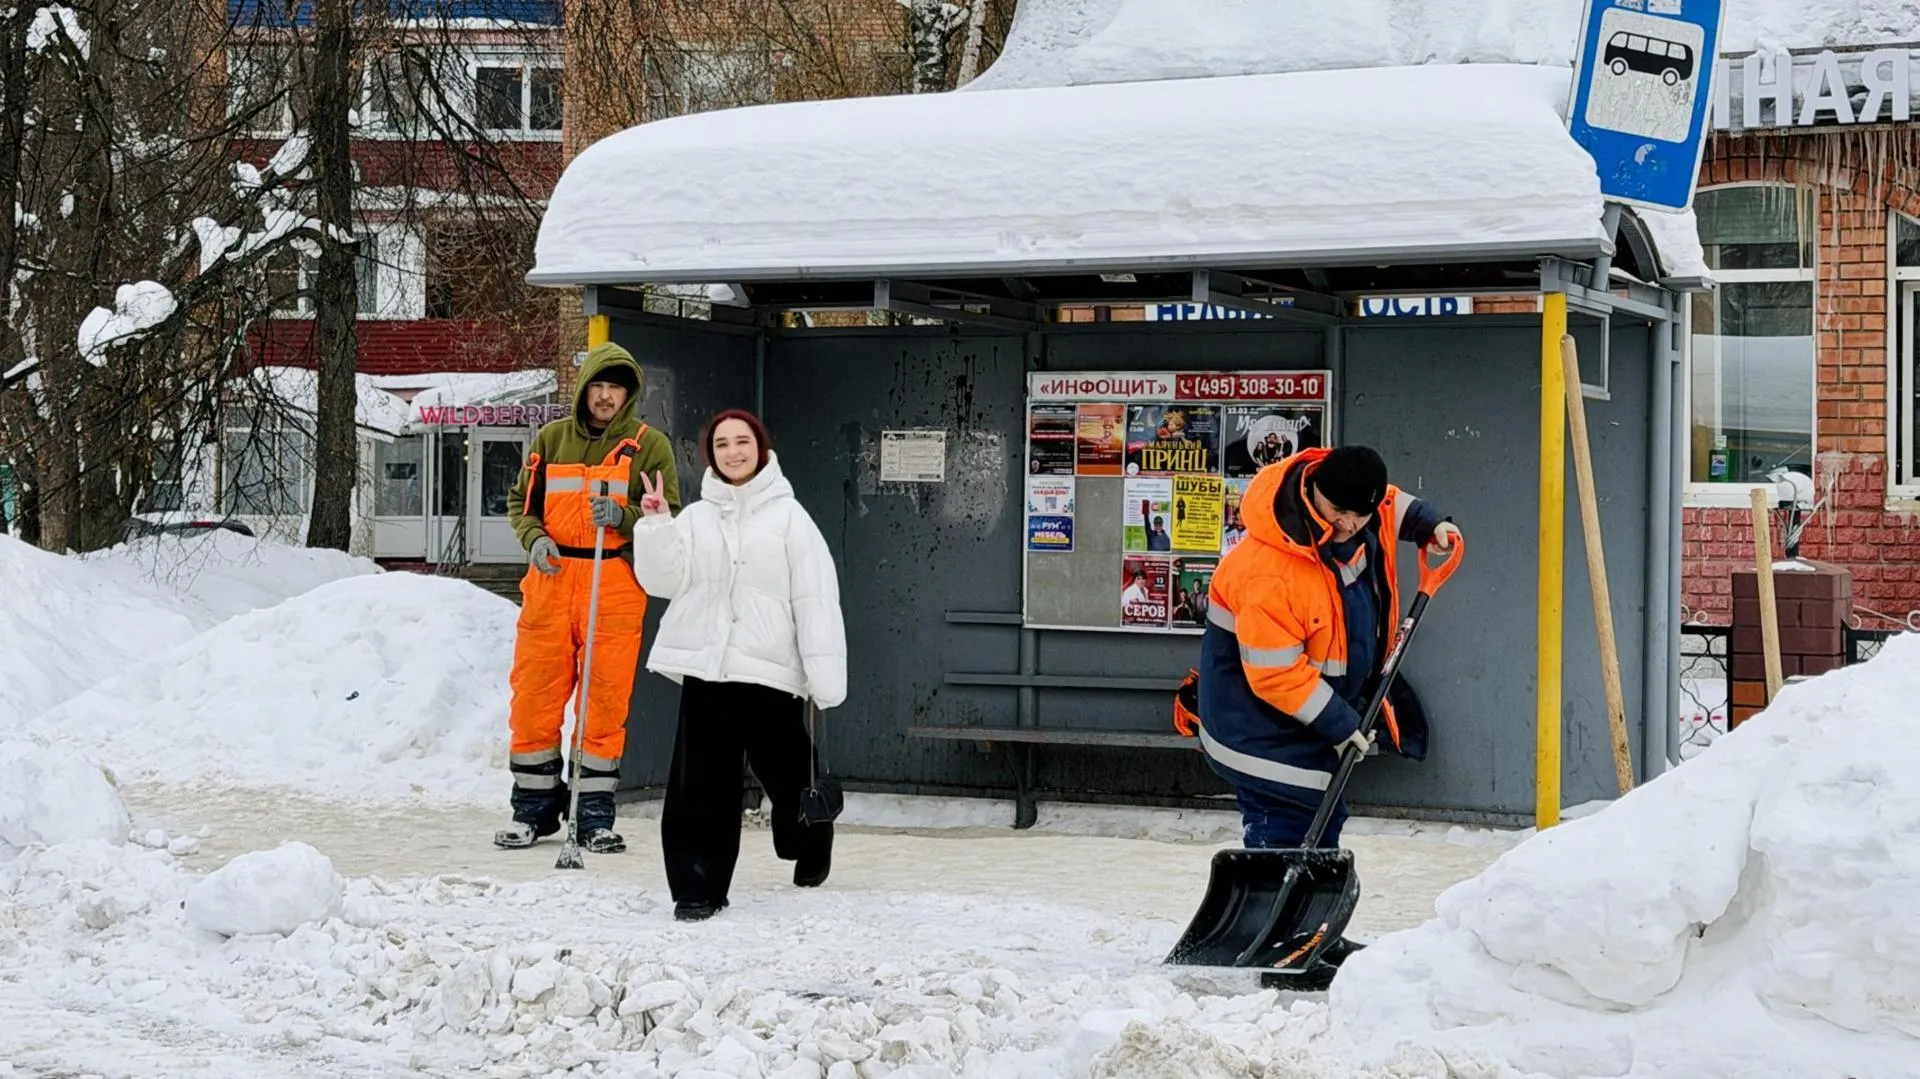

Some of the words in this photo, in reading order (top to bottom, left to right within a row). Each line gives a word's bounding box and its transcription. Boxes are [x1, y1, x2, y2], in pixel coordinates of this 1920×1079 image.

[1713, 48, 1910, 129] НАЯ
[1040, 379, 1168, 397] «ИНФОЩИТ»
[1195, 378, 1235, 396] (495)
[1239, 378, 1319, 395] 308-30-10
[1141, 449, 1208, 472] ПРИНЦ
[1176, 481, 1221, 493] ШУБЫ
[1124, 604, 1166, 618] СЕРОВ
